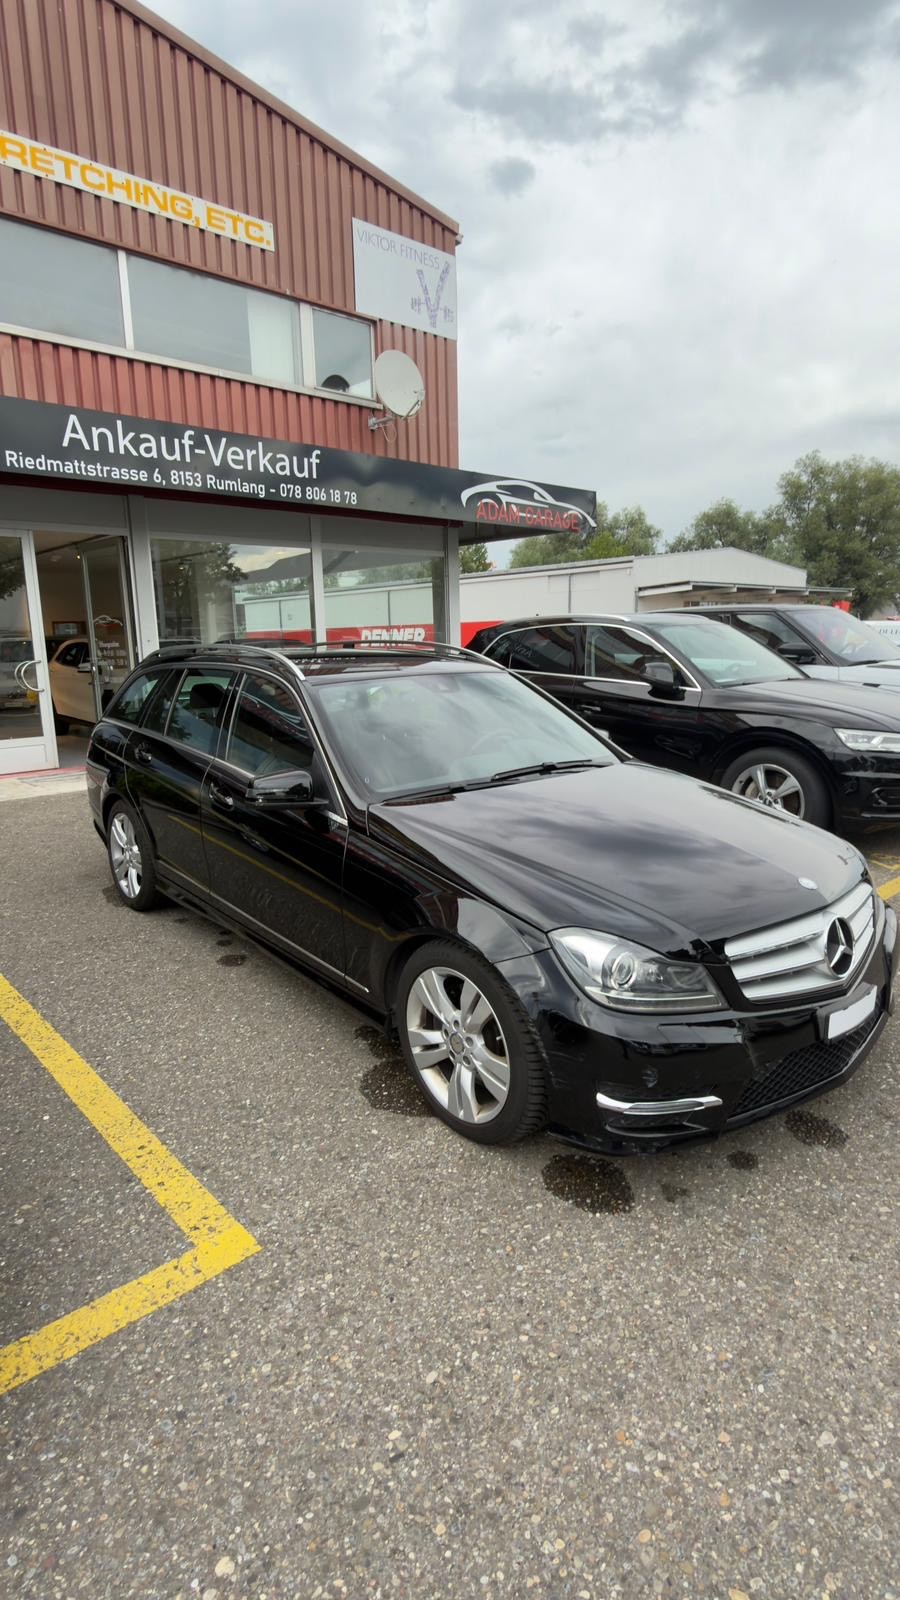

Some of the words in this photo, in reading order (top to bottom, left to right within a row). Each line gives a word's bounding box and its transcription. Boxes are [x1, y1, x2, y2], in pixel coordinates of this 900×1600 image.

[206, 205, 271, 246] ETC.
[357, 228, 397, 253] VIKTOR
[400, 244, 440, 270] FITNESS
[62, 414, 321, 479] Ankauf-Verkauf
[5, 450, 149, 482] Riedmattstrasse
[153, 468, 166, 486] 6,
[170, 470, 202, 487] 8153
[206, 474, 266, 498] Rumlang
[280, 483, 302, 499] 078
[306, 487, 327, 502] 806
[330, 489, 341, 503] 18
[344, 491, 357, 505] 78
[476, 501, 520, 524] ADAM
[525, 507, 579, 530] GARAGE
[360, 627, 426, 647] DENNER
